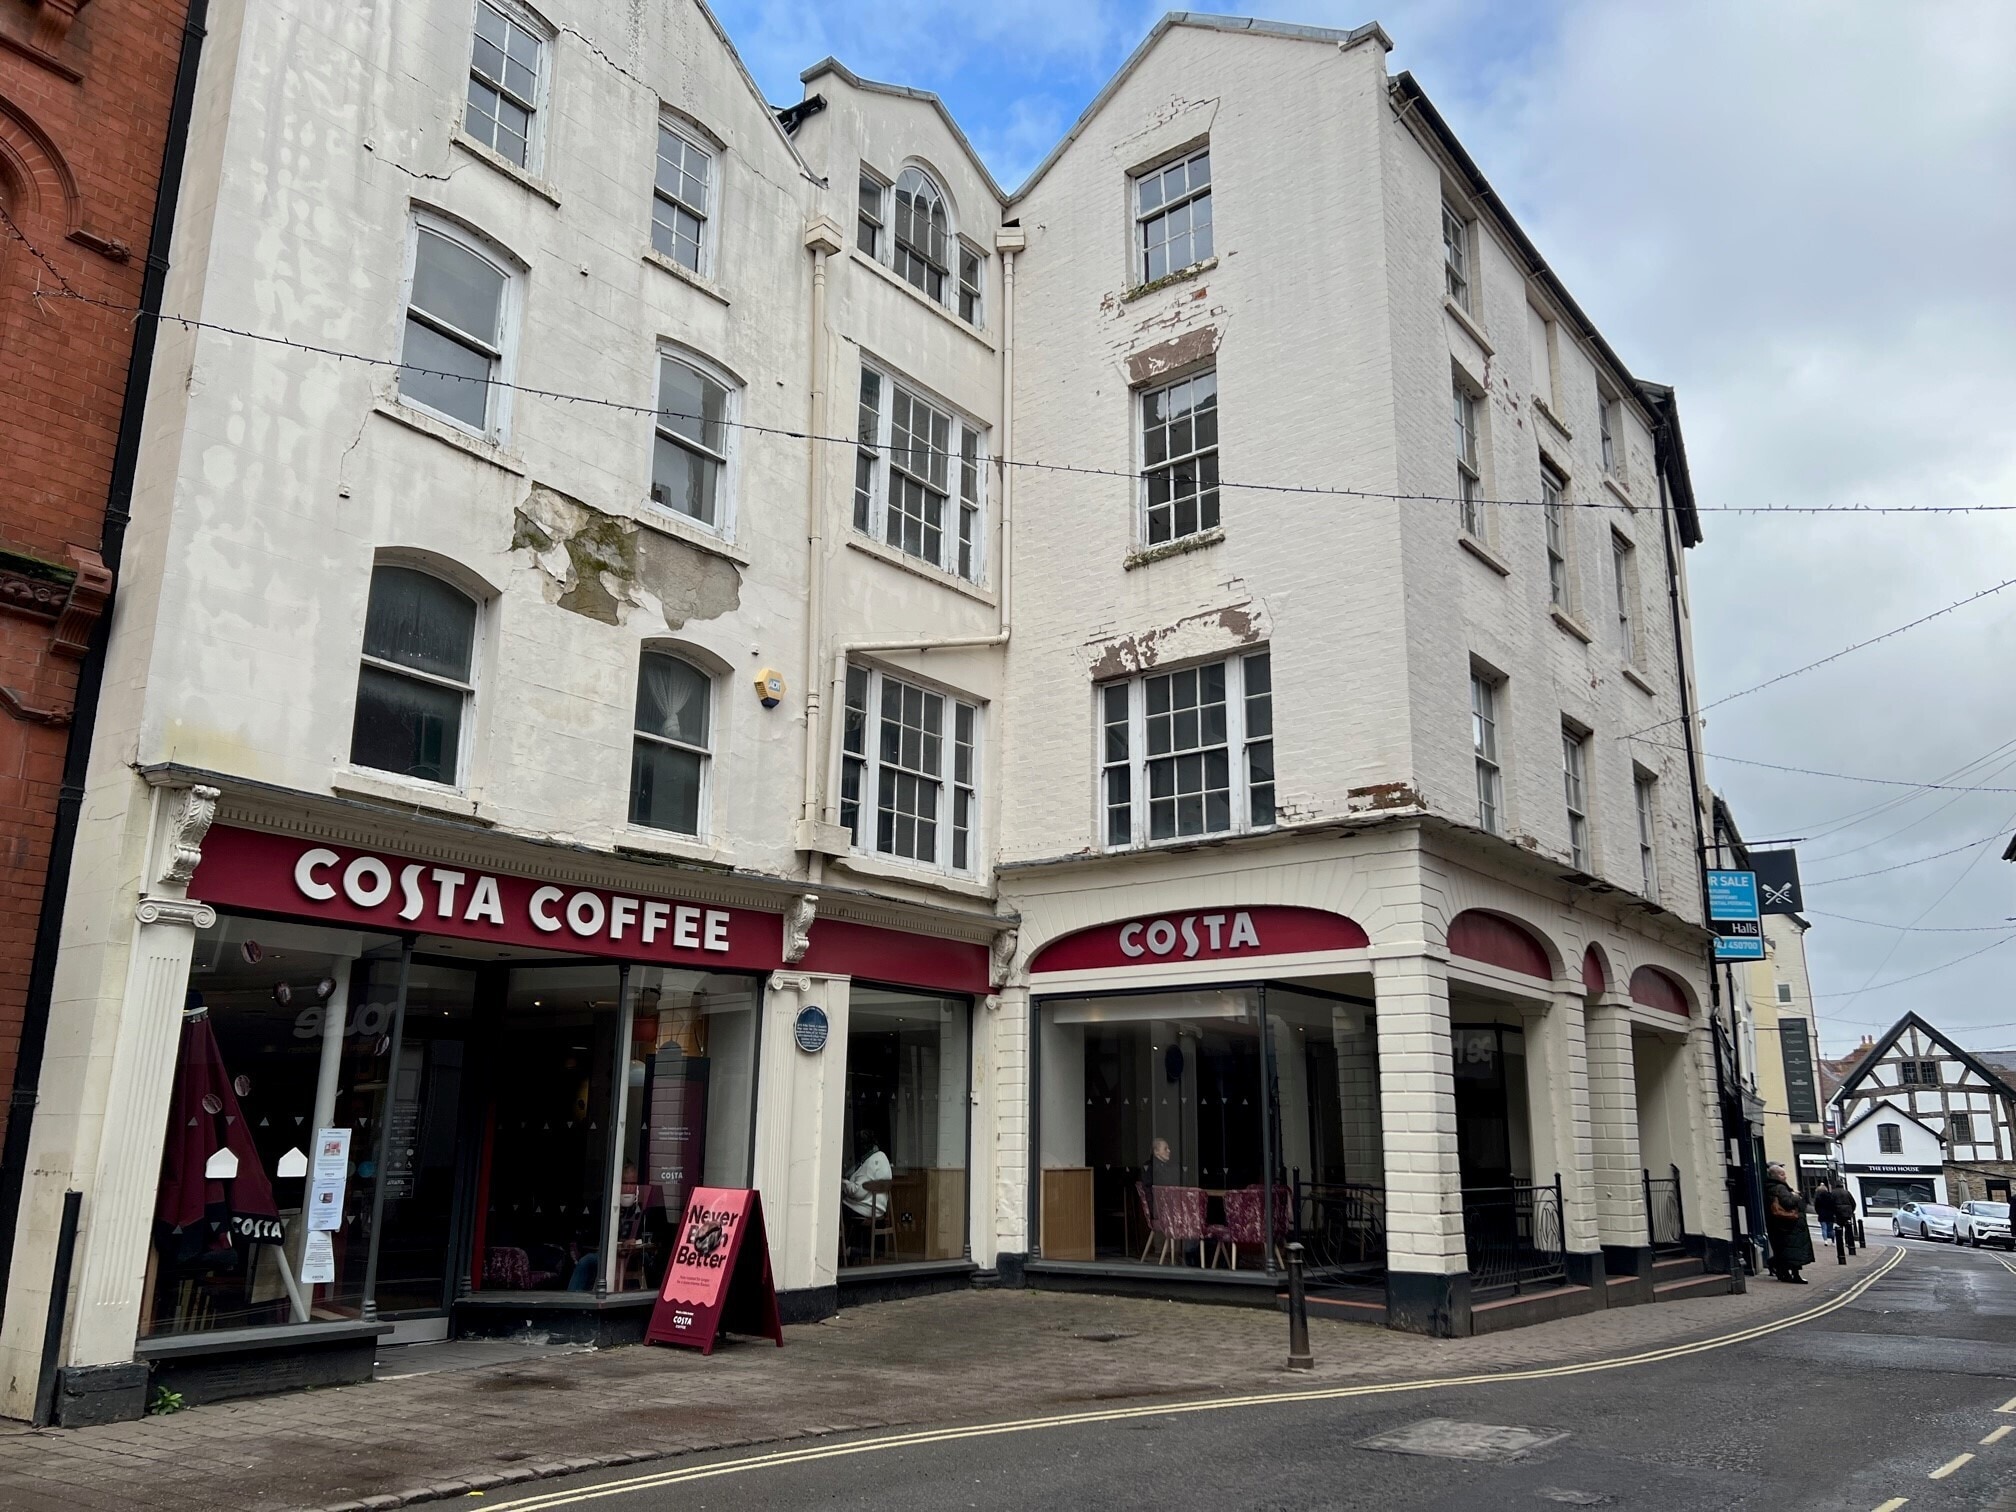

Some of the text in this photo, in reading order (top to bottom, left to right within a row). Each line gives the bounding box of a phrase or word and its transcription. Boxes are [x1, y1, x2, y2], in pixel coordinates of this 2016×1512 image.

[1720, 876, 1749, 887] SALE
[294, 847, 730, 952] COSTA COFFEE
[1732, 923, 1757, 934] Halls
[1119, 911, 1261, 958] COSTA
[1728, 941, 1758, 950] 450700
[661, 1171, 683, 1180] COSTA
[688, 1205, 739, 1228] Never
[676, 1246, 727, 1269] Better
[673, 1315, 692, 1326] COSTA
